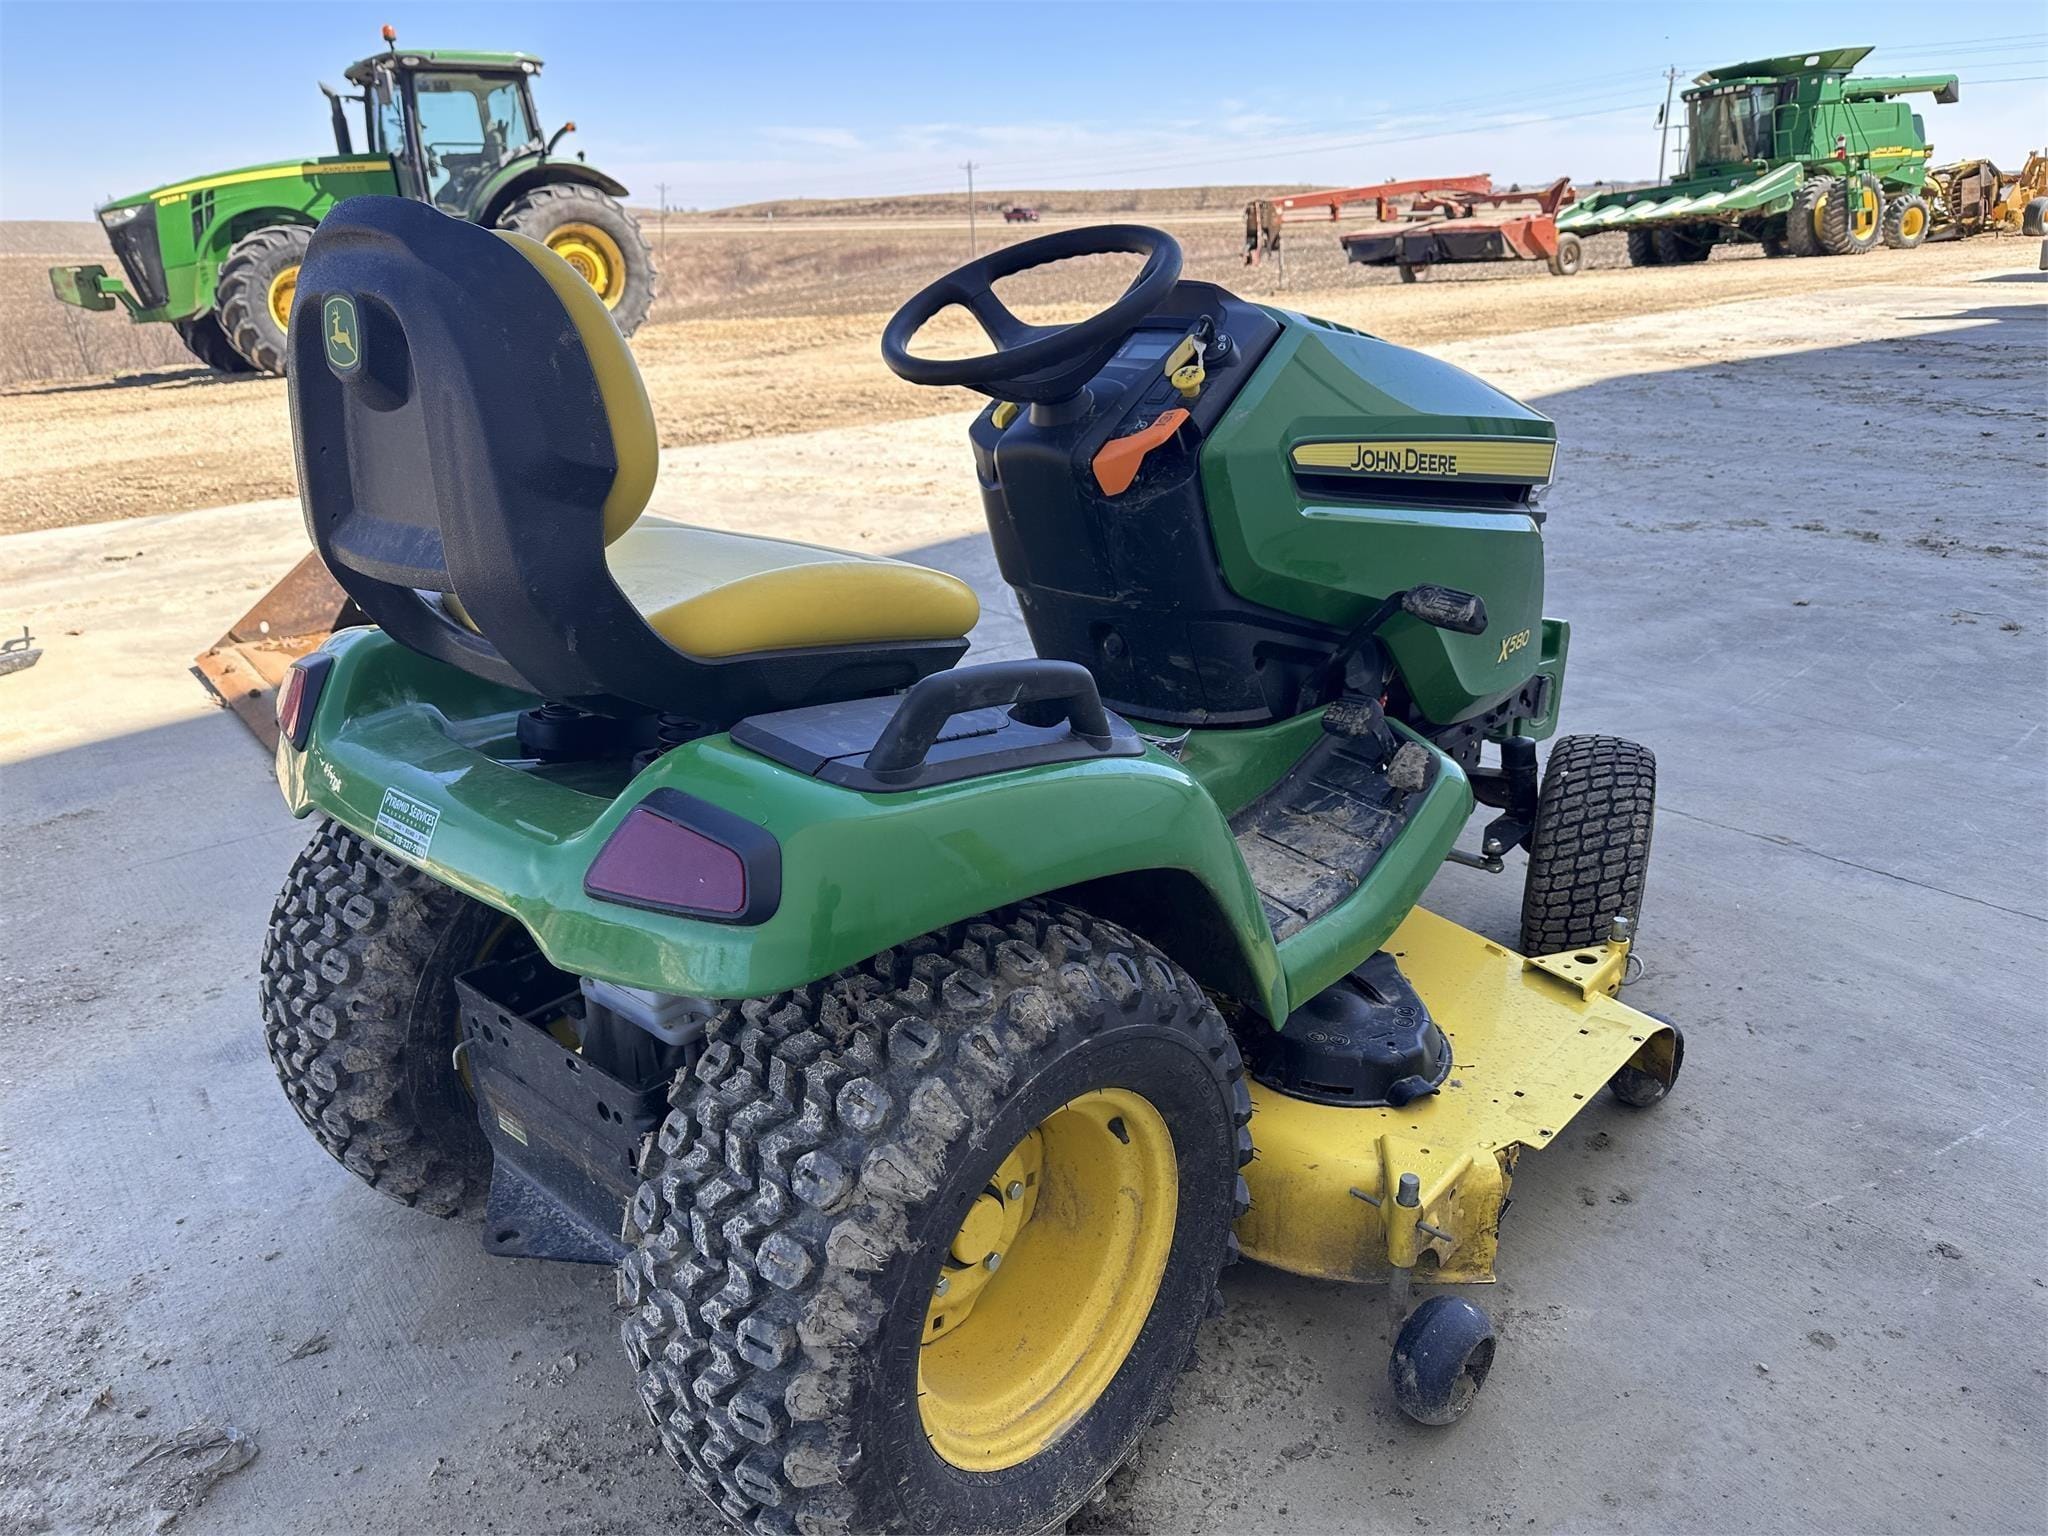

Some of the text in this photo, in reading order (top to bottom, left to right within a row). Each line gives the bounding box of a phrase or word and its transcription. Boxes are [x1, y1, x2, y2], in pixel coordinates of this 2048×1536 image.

[1351, 445, 1457, 473] JOHN DEERE
[1497, 629, 1530, 664] X580
[408, 804, 435, 827] SERVICES
